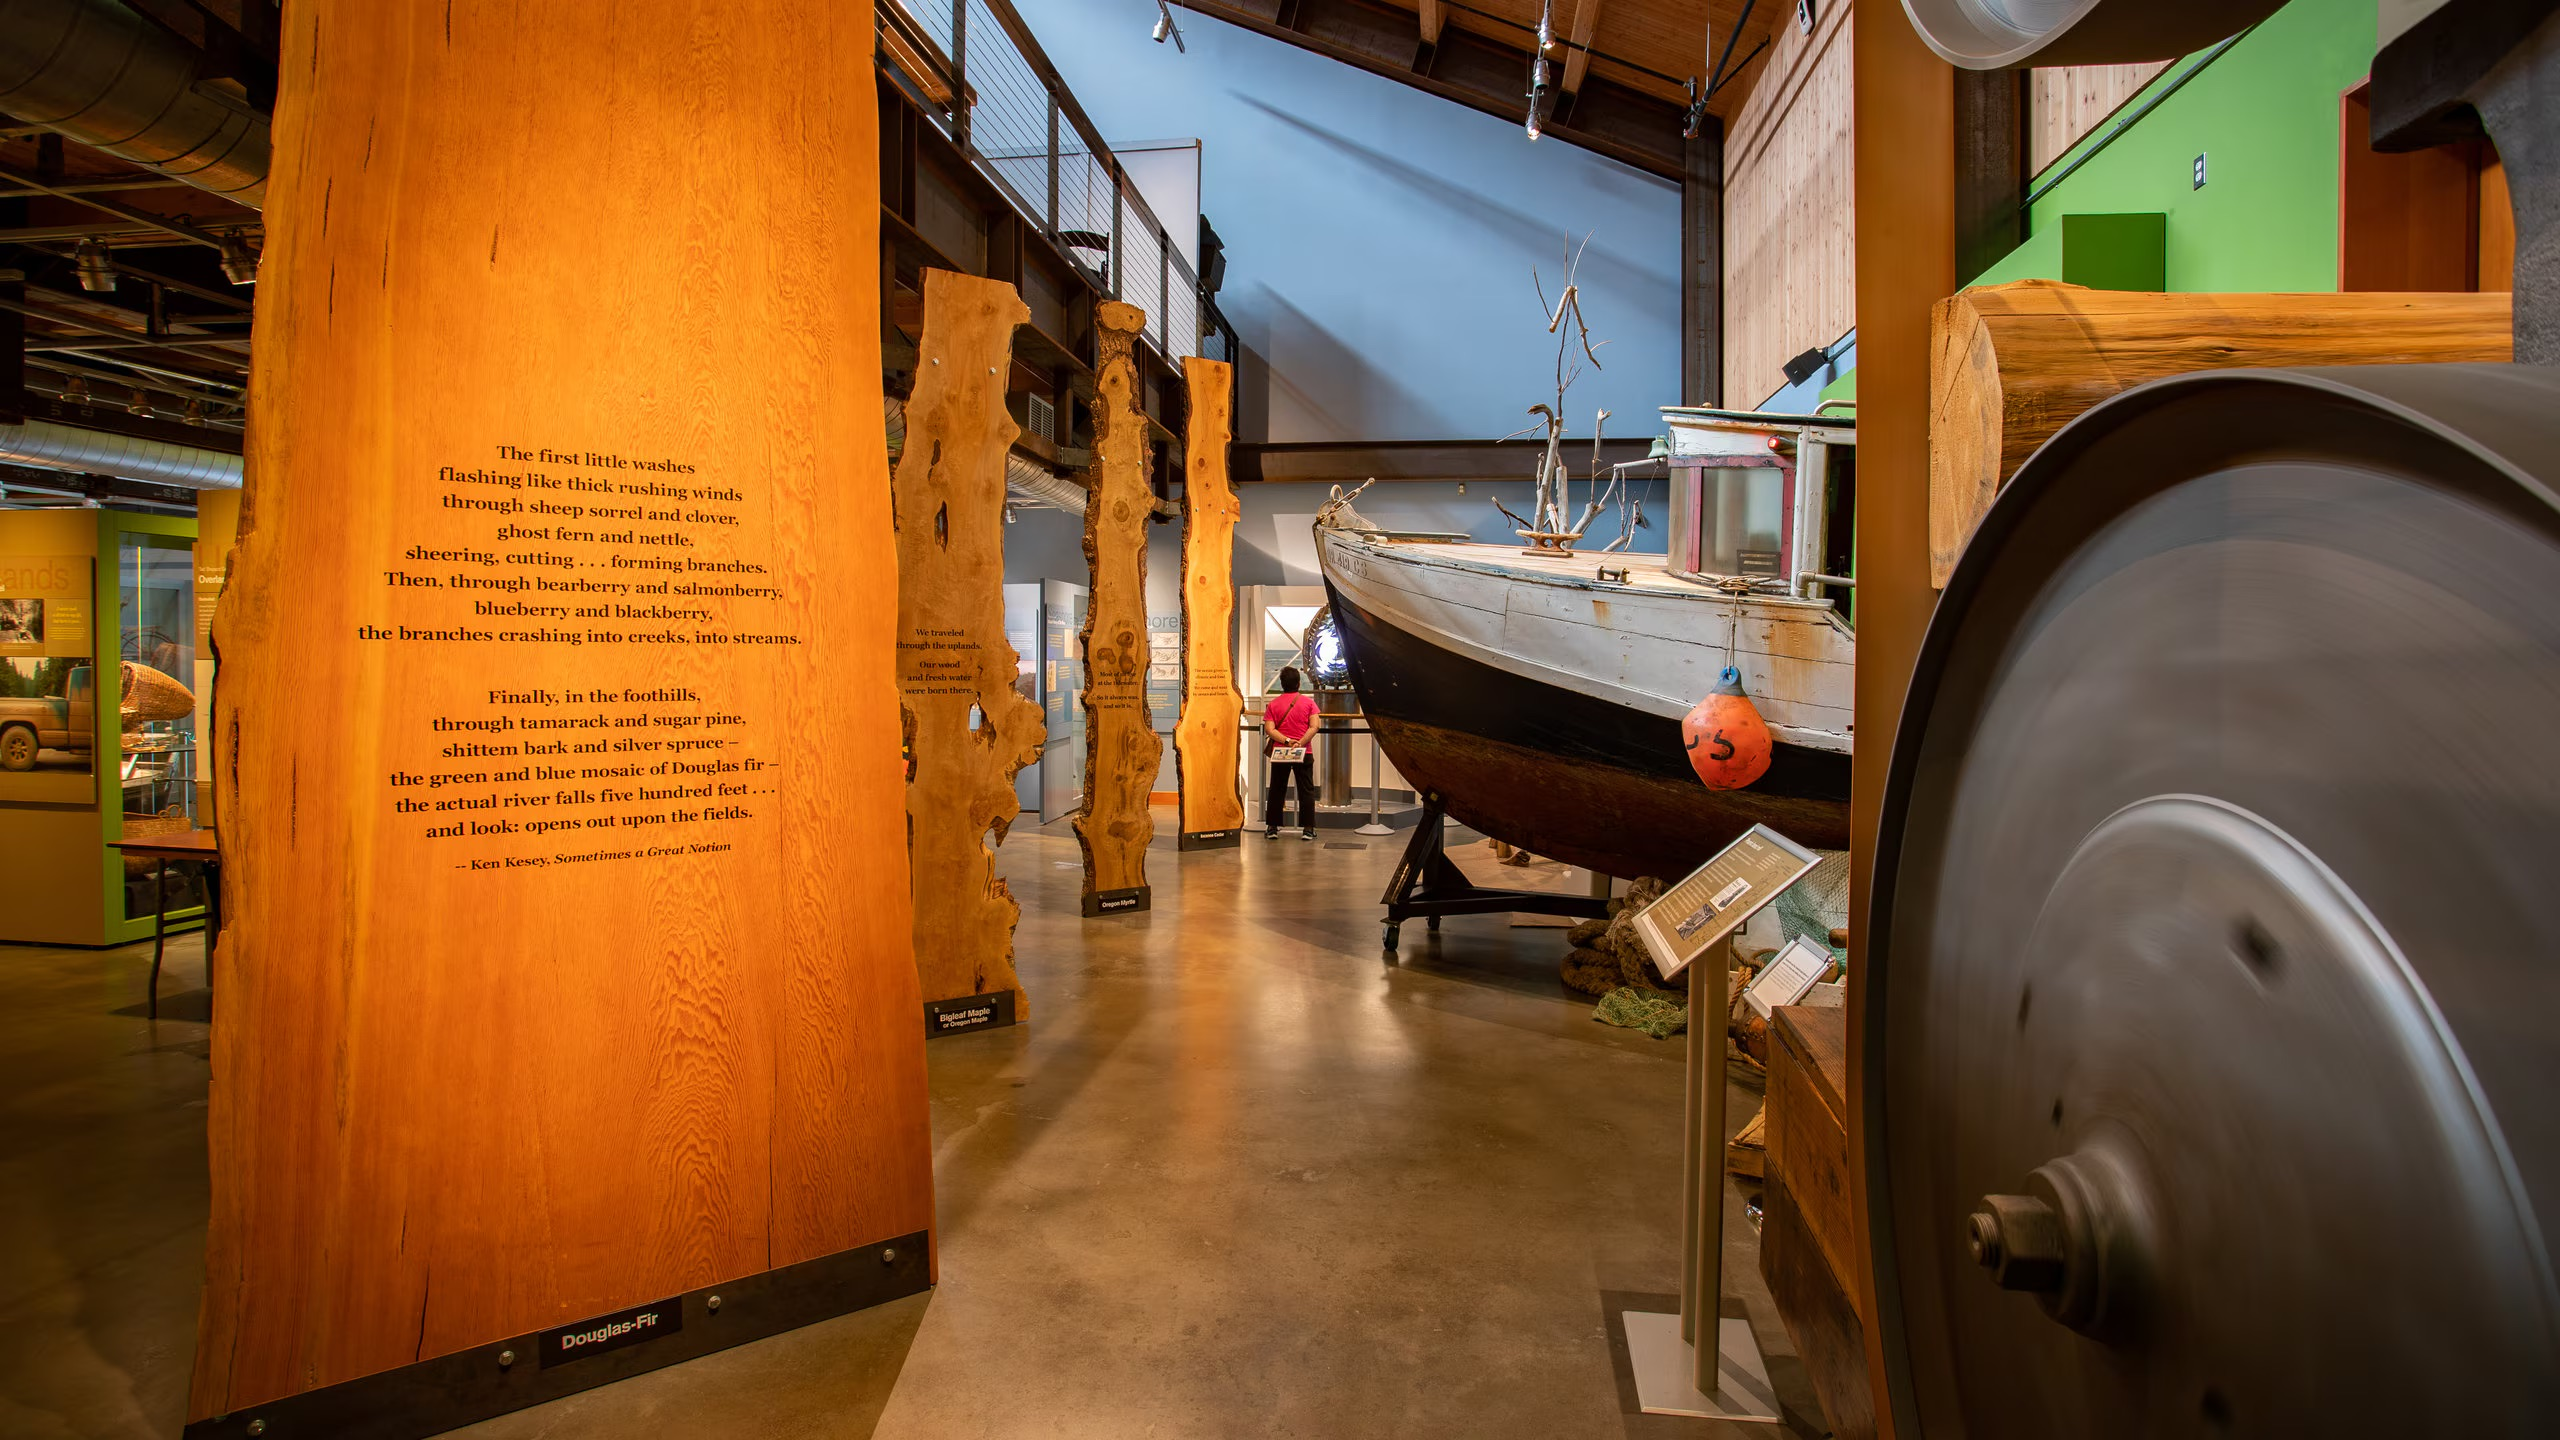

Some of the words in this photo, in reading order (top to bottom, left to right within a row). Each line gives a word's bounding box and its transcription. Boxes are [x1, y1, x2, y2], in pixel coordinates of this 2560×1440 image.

[496, 445, 534, 462] The
[538, 448, 580, 466] first
[585, 452, 628, 469] little
[631, 458, 696, 474] washes
[438, 466, 522, 490] flashing
[526, 472, 562, 490] like
[567, 476, 614, 493] thick
[618, 481, 688, 501] rushing
[691, 486, 743, 502] winds
[441, 493, 524, 515] through
[529, 499, 584, 520] sheep
[588, 506, 643, 520] sorrel
[647, 508, 681, 522] and
[685, 509, 740, 527] clover,
[497, 523, 550, 541] ghost
[555, 526, 594, 542] fern
[599, 530, 634, 544] and
[639, 532, 694, 548] nettle,
[405, 544, 500, 567] sheering,
[505, 551, 574, 570] cutting
[610, 554, 683, 574] forming
[687, 557, 768, 574] branches.
[383, 571, 444, 590] Then,
[449, 573, 531, 594] through
[536, 576, 631, 597] bearberry
[635, 580, 668, 595] and
[673, 581, 783, 601] salmonberry,
[474, 600, 571, 621] blueberry
[574, 603, 610, 618] and
[615, 604, 713, 623] blackberry,
[357, 624, 393, 641] the
[398, 625, 494, 642] branches
[498, 627, 582, 646] crashing
[586, 628, 623, 643] into
[627, 629, 690, 644] creeks,
[695, 630, 728, 644] into
[732, 632, 802, 645] streams.
[916, 628, 929, 637] We
[931, 629, 964, 637] traveled
[896, 641, 930, 650] through
[948, 642, 982, 651] uplands.
[488, 689, 560, 707] Finally,
[565, 689, 584, 704] in
[588, 688, 619, 703] the
[623, 688, 701, 703] foothills,
[905, 687, 926, 695] were
[927, 687, 948, 695] born
[950, 686, 973, 694] there.
[1109, 693, 1127, 701] always
[431, 715, 515, 734] through
[519, 713, 610, 730] tamarack
[614, 713, 649, 728] and
[652, 716, 702, 729] sugar
[705, 711, 747, 729] pine,
[442, 742, 518, 758] shittem
[523, 740, 569, 756] bark
[573, 738, 608, 754] and
[613, 737, 663, 753] silver
[666, 739, 724, 754] spruce
[389, 771, 424, 787] the
[429, 772, 488, 789] green
[493, 766, 530, 783] and
[535, 765, 576, 781] blue
[581, 763, 645, 779] mosaic
[649, 761, 669, 776] of
[671, 759, 740, 777] Douglas
[743, 757, 765, 772] fir
[394, 797, 430, 813] the
[435, 793, 497, 812] actual
[503, 792, 551, 808] river
[555, 789, 596, 805] falls
[599, 788, 634, 803] five
[639, 783, 713, 801] hundred
[717, 782, 748, 797] feet
[425, 821, 465, 839] and
[469, 819, 519, 836] look:
[524, 819, 582, 835] opens
[585, 815, 616, 829] out
[621, 814, 666, 829] upon
[670, 809, 699, 823] the
[703, 805, 753, 821] fields.
[471, 859, 500, 871] Ken
[504, 856, 551, 868] Kesey,
[553, 849, 631, 864] Sometimes
[634, 850, 644, 858] a
[647, 845, 685, 857] Great
[687, 841, 731, 854] Notion
[1102, 901, 1120, 909] Oregon
[1121, 899, 1136, 908] Myrtle
[940, 1010, 967, 1023] Bigleaf
[967, 1007, 991, 1019] Maple
[950, 1019, 971, 1028] Oregon
[971, 1015, 989, 1024] Maple
[562, 1312, 659, 1350] Douglas-Fir
